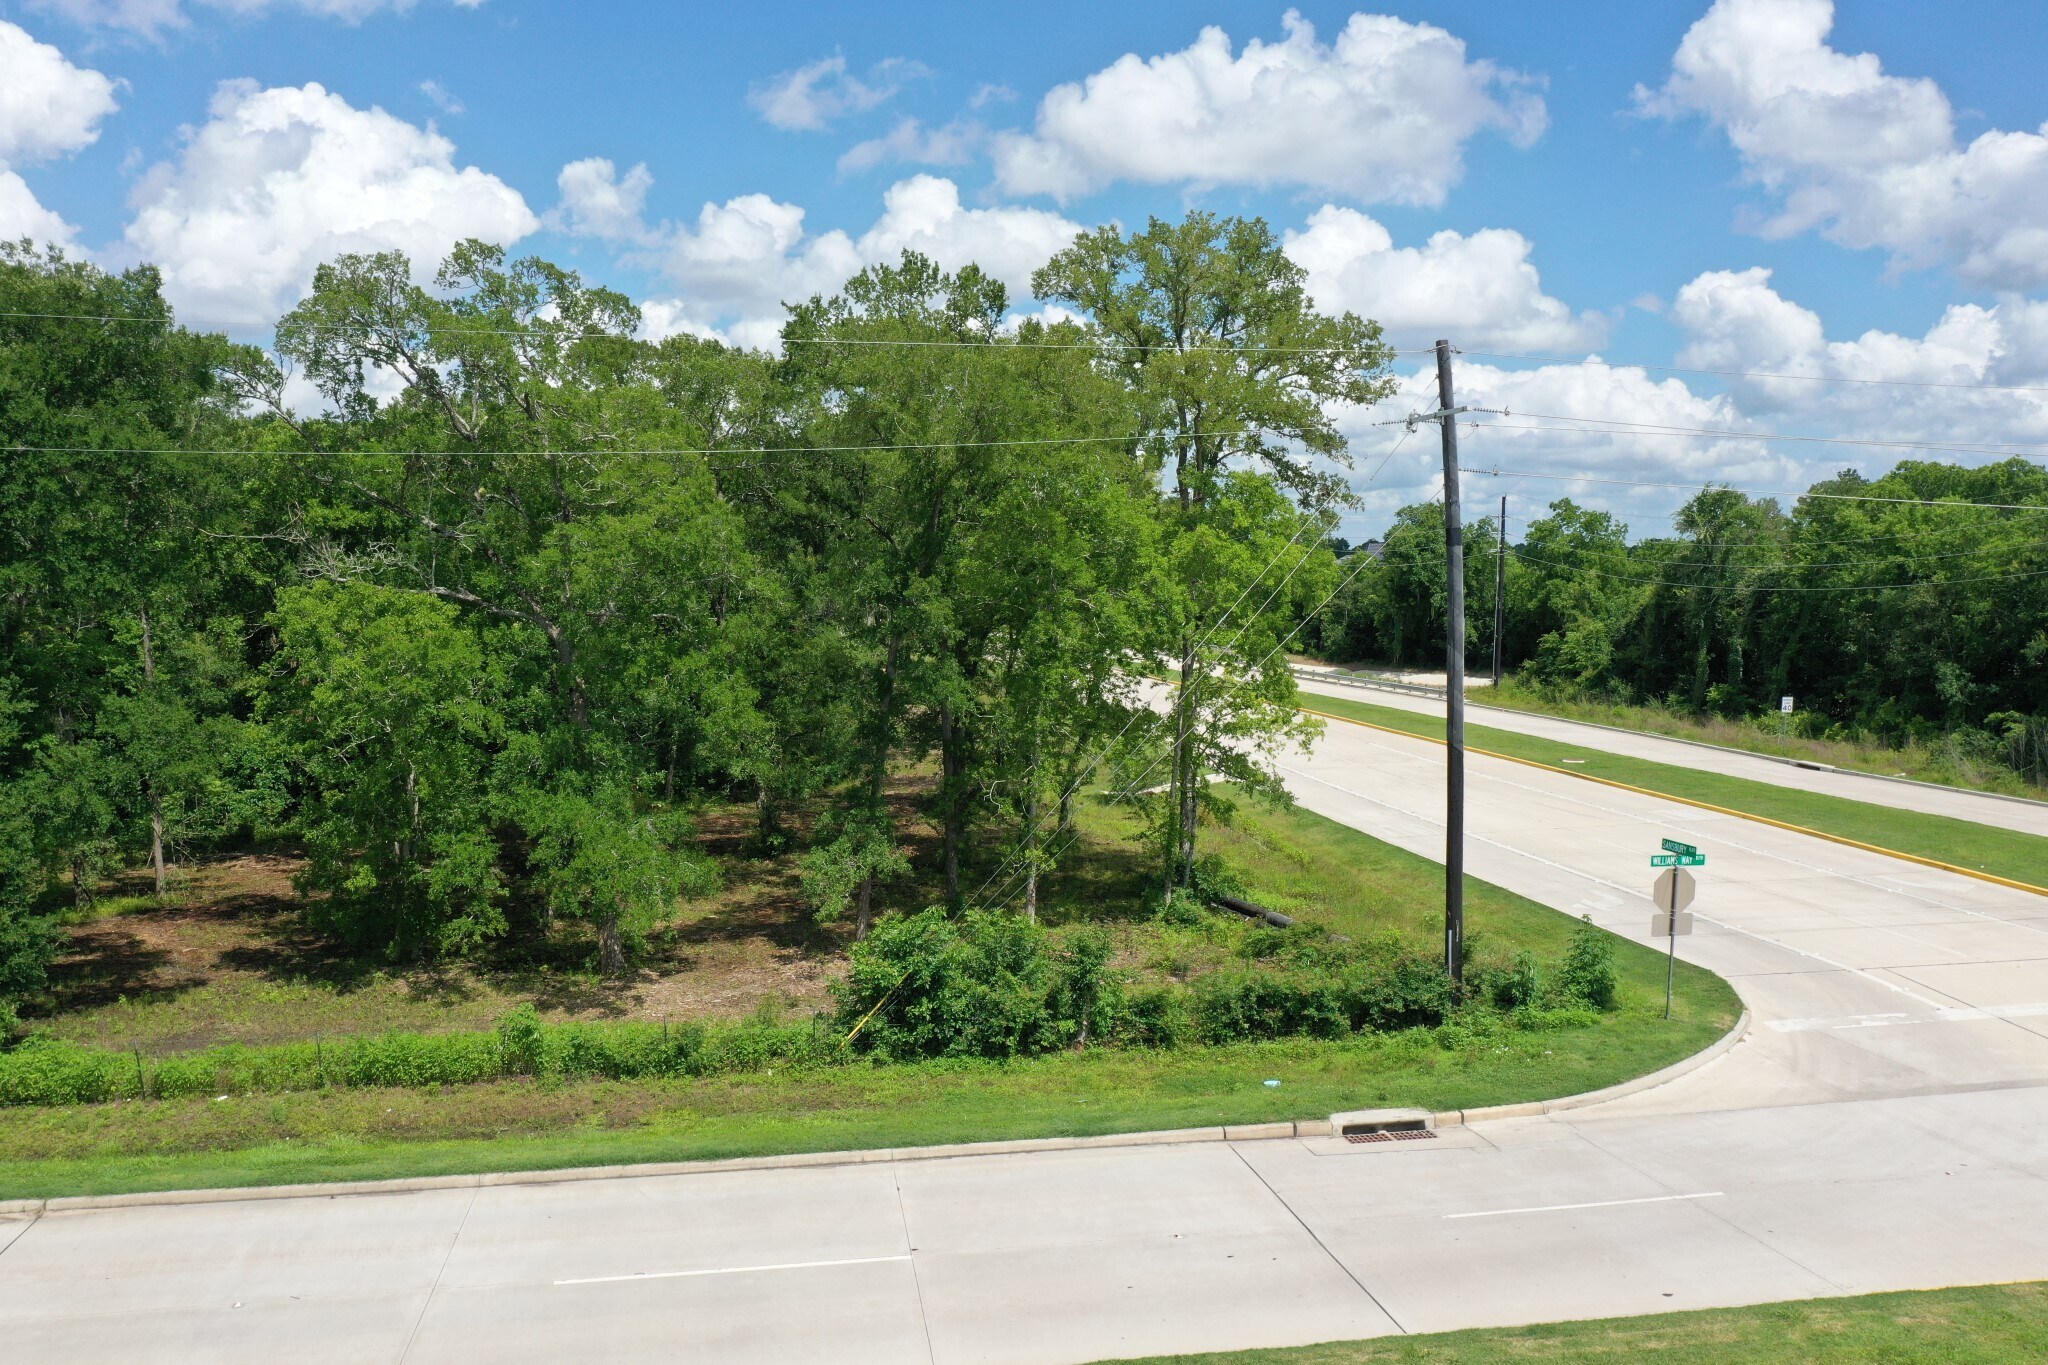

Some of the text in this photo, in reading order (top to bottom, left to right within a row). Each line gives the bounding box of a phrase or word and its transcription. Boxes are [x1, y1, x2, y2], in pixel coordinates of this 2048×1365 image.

[1662, 840, 1688, 854] SANSBURY
[1652, 856, 1678, 865] WILLIAMS
[1682, 856, 1692, 864] WAY
